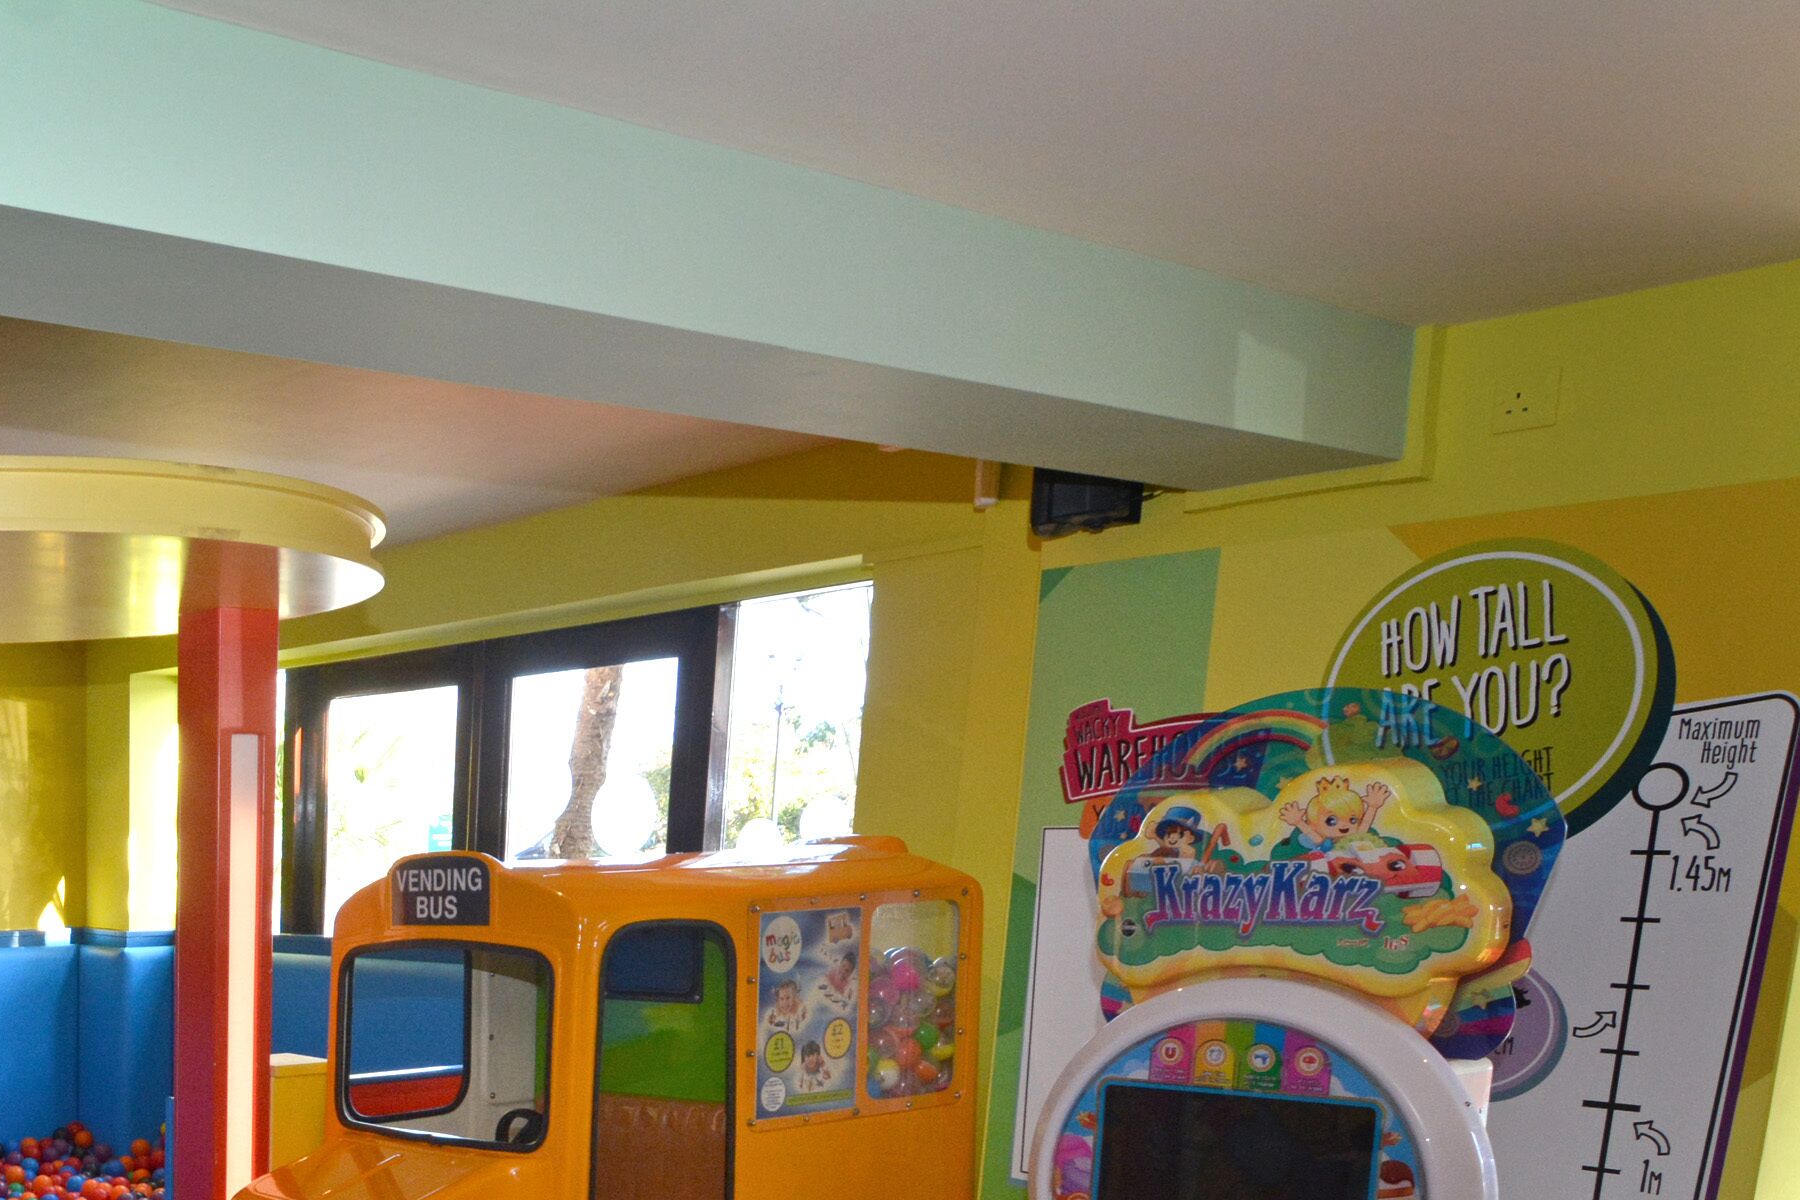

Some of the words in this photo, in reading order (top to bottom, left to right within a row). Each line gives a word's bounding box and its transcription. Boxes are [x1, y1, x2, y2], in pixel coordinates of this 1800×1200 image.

[1381, 594, 1461, 678] HOW
[1469, 578, 1569, 657] TALL
[1376, 677, 1440, 749] ARE
[1451, 653, 1571, 740] YOU?
[1075, 716, 1120, 745] WACKY
[1678, 718, 1760, 740] Maximum
[1492, 746, 1554, 777] HEIGHT
[1700, 739, 1758, 770] Height
[396, 867, 482, 892] VENDING
[1669, 855, 1732, 892] 1.45M
[416, 895, 458, 919] BUS
[766, 931, 800, 950] magic
[768, 948, 791, 964] bus
[1640, 1159, 1662, 1195] 1M
